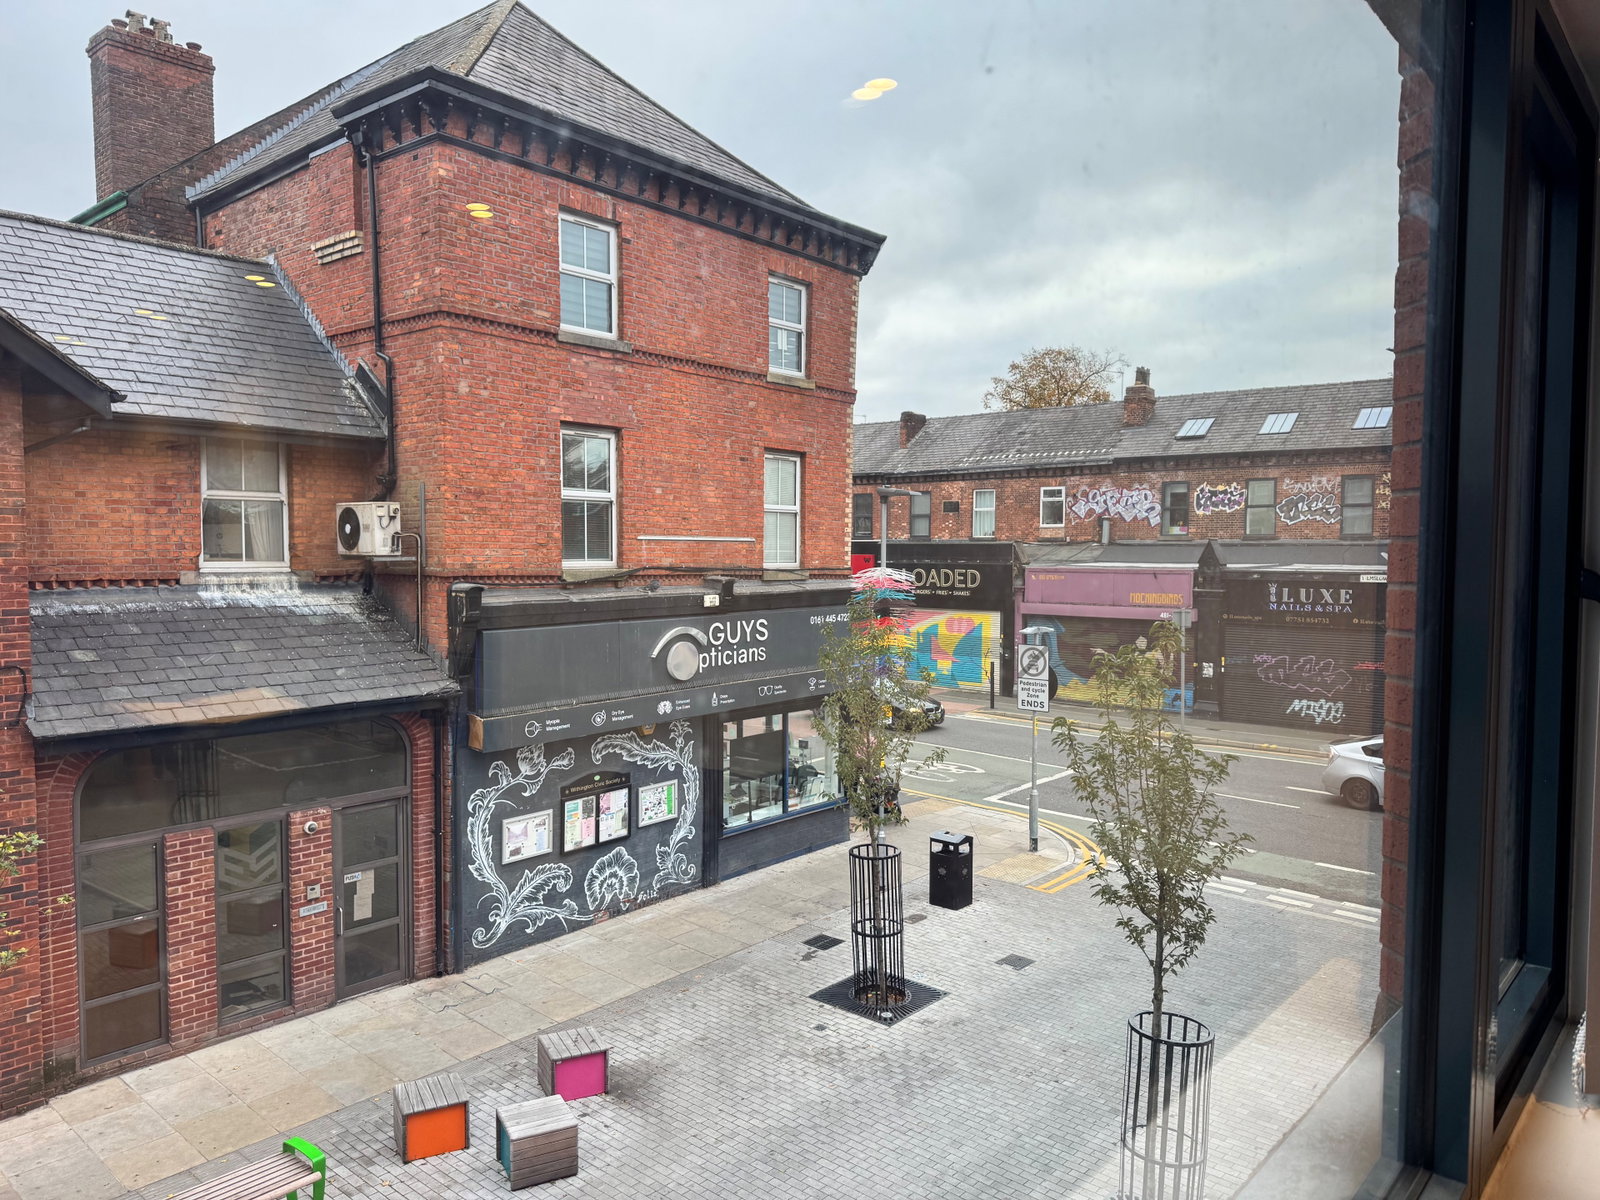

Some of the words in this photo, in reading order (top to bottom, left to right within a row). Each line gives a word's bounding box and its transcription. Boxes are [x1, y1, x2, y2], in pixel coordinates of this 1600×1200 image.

[903, 567, 981, 588] OADED
[1269, 603, 1312, 612] NAILS
[1326, 605, 1353, 613] SPA
[825, 614, 836, 622] 445
[709, 619, 769, 645] GUYS
[1019, 680, 1047, 688] Pedestrian
[1021, 699, 1045, 709] ENDS
[570, 783, 594, 793] Withington
[594, 780, 605, 788] Civic
[605, 777, 621, 785] Society
